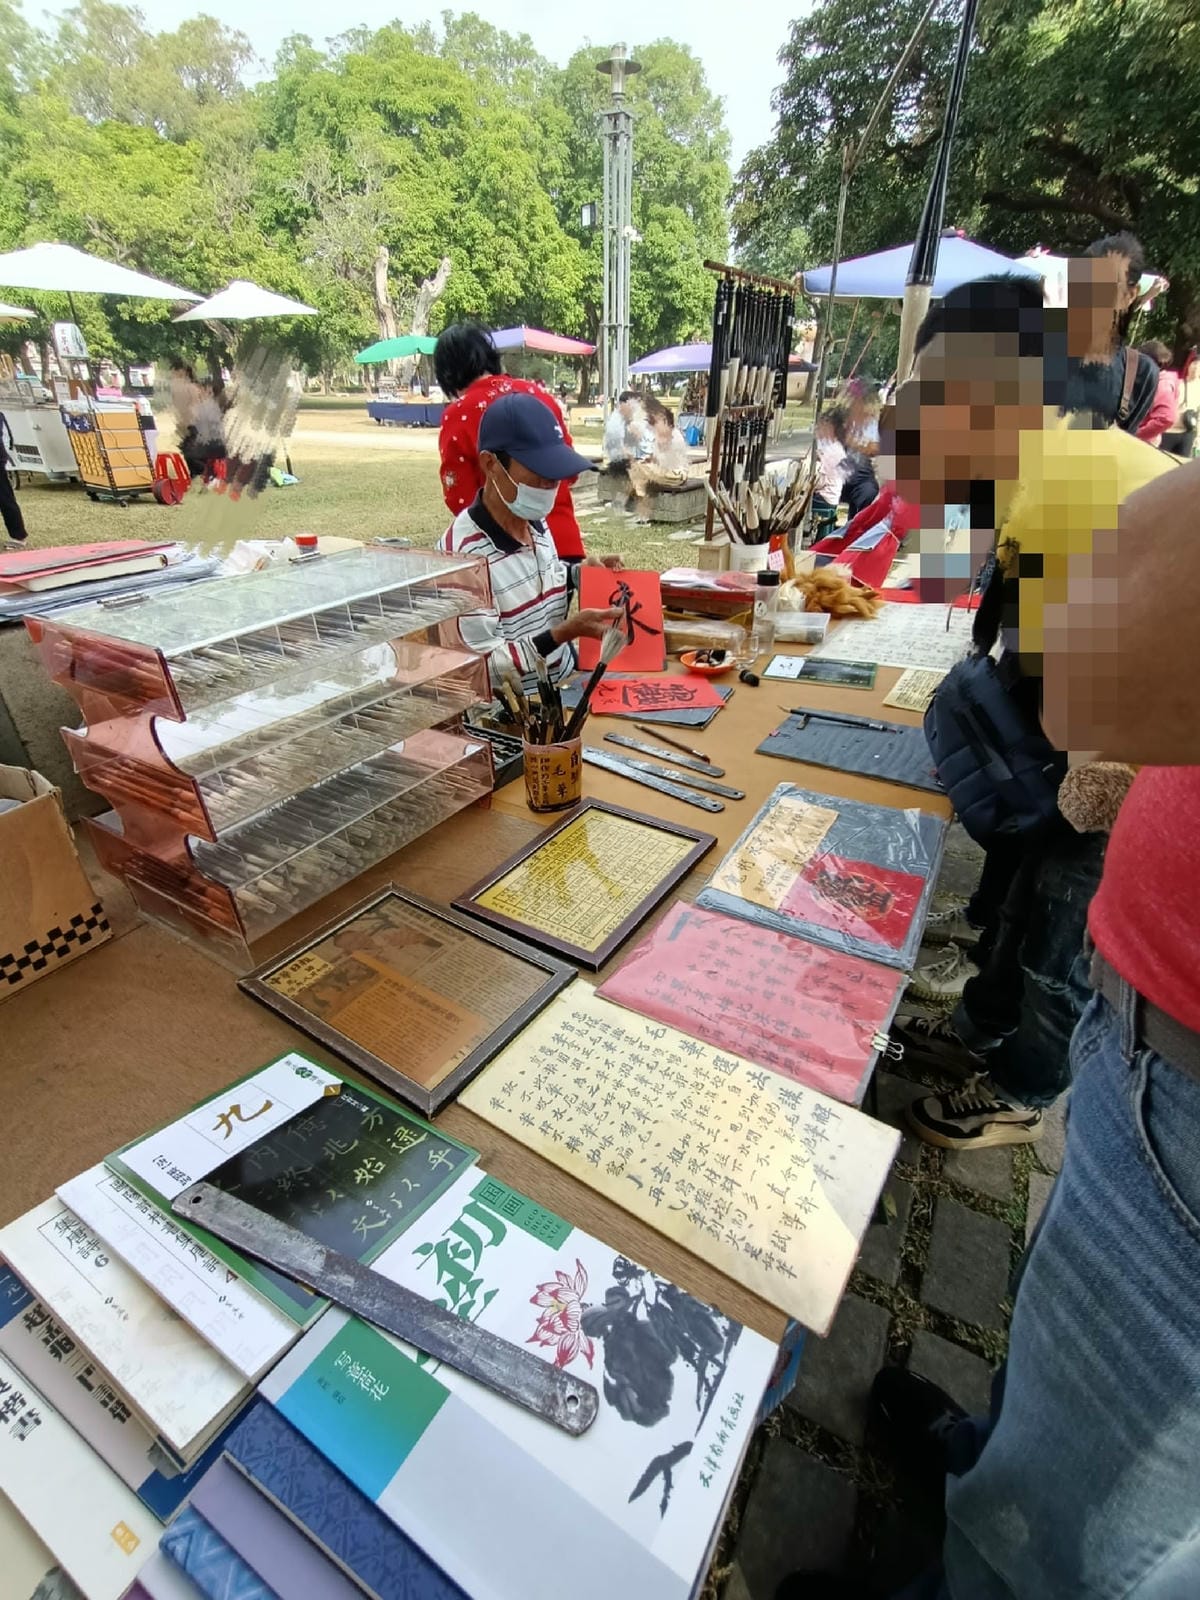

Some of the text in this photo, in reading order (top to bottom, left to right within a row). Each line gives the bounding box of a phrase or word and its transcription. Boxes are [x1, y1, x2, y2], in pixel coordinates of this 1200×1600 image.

[211, 1099, 273, 1141] 九
[52, 1217, 110, 1269] 集唐詩 6
[333, 1353, 390, 1402] 写意荷花
